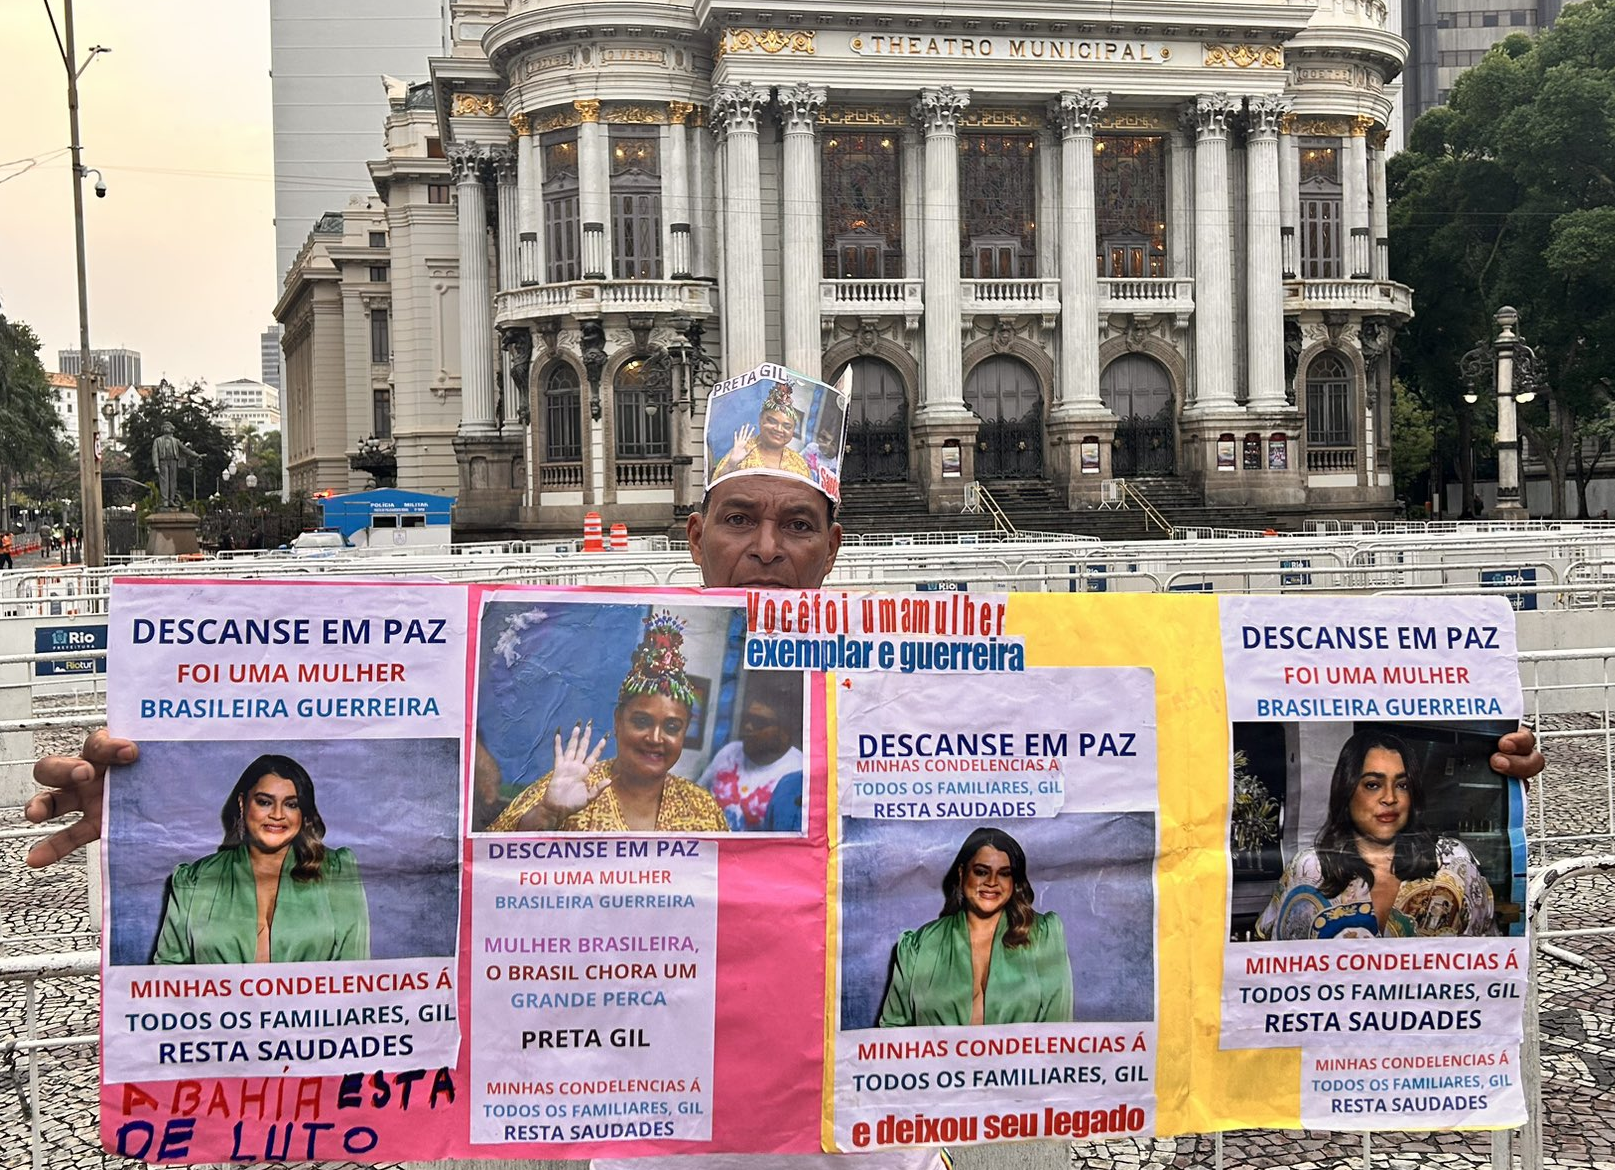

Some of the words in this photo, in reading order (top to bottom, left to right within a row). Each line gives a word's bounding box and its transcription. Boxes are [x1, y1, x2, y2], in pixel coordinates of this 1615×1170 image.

[872, 36, 992, 56] THEATRO
[1009, 40, 1153, 60] MUNICIPAL
[713, 371, 756, 396] PRETA
[760, 364, 787, 382] GIL
[69, 632, 94, 644] Rio
[133, 618, 309, 645] DESCANSE
[322, 619, 370, 645] EM
[383, 619, 447, 644] PAZ
[1242, 627, 1388, 649] DESCANSE
[1400, 627, 1436, 649] EM
[1450, 627, 1500, 649] PAZ
[747, 635, 873, 670] exemplar
[879, 641, 895, 669] e
[900, 636, 1024, 672] guerreira
[66, 661, 93, 670] Riotur
[177, 664, 219, 683] FOI
[229, 663, 289, 683] UMA
[298, 663, 406, 682] MULHER
[1284, 667, 1318, 684] FOI
[1327, 667, 1377, 684] UMA
[1383, 667, 1470, 684] MULHER
[140, 698, 289, 718] BRASILEIRA
[297, 697, 440, 717] GUERREIRA
[1257, 699, 1379, 717] BRASILEIRA
[1386, 698, 1502, 716] GUERREIRA
[859, 733, 1014, 758] DESCANSE
[1025, 733, 1068, 757] EM
[1079, 733, 1137, 757] PAZ
[856, 759, 920, 773] MINHAS
[925, 758, 1042, 772] CONDELENCIAS
[854, 782, 908, 796] TODOS
[913, 781, 933, 795] OS
[938, 781, 1033, 796] FAMILIARES,
[1038, 781, 1063, 794] GIL
[874, 802, 930, 818] RESTA
[936, 802, 1036, 818] SAUDADES
[488, 841, 607, 859] DESCANSE
[615, 841, 648, 858] EM
[657, 841, 699, 857] PAZ
[519, 872, 548, 885] FOI
[553, 871, 594, 885] UMA
[600, 870, 672, 884] MULHER
[495, 896, 593, 910] BRASILEIRA
[599, 894, 695, 908] GUERREIRA
[485, 937, 571, 953] MULHER
[578, 936, 699, 954] BRASILEIRA,
[486, 966, 501, 981] O
[508, 964, 579, 981] BRASIL
[585, 963, 657, 980] CHORA
[664, 963, 697, 978] UM
[1246, 956, 1329, 975] MINHAS
[1336, 953, 1499, 972] CONDELENCIAS
[1505, 949, 1519, 969] Á
[130, 978, 232, 998] MINHAS
[240, 972, 429, 996] CONDELENCIAS
[435, 967, 452, 989] Á
[1239, 986, 1311, 1004] TODOS
[1318, 984, 1345, 1001] OS
[1352, 983, 1481, 1002] FAMILIARES,
[1487, 982, 1520, 998] GIL
[511, 993, 596, 1008] GRANDE
[603, 991, 667, 1007] PERCA
[125, 1012, 212, 1032] TODOS
[220, 1011, 251, 1030] OS
[260, 1005, 410, 1028] FAMILIARES,
[418, 1004, 456, 1023] GIL
[1265, 1012, 1341, 1033] RESTA
[1348, 1009, 1482, 1031] SAUDADES
[159, 1041, 249, 1064] RESTA
[258, 1034, 414, 1061] SAUDADES
[522, 1029, 602, 1049] PRETA
[609, 1028, 650, 1047] GIL
[858, 1040, 948, 1060] MINHAS
[955, 1036, 1125, 1057] CONDELENCIAS
[1131, 1032, 1147, 1052] Á
[1315, 1058, 1377, 1071] MINHAS
[1381, 1054, 1494, 1069] CONDELENCIAS
[1498, 1050, 1509, 1065] Á
[487, 1081, 554, 1095] MINHAS
[559, 1080, 685, 1095] CONDELENCIAS
[690, 1077, 701, 1093] Á
[852, 1073, 929, 1092] TODOS
[936, 1071, 965, 1088] OS
[973, 1067, 1107, 1087] FAMILIARES,
[1114, 1066, 1149, 1083] GIL
[1312, 1079, 1364, 1092] TODOS
[1369, 1079, 1388, 1091] OS
[1393, 1076, 1484, 1090] FAMILIARES,
[1489, 1074, 1512, 1086] GIL
[122, 1082, 159, 1116] A
[337, 1067, 456, 1110] ESTA
[483, 1104, 540, 1118] TODOS
[546, 1104, 567, 1117] OS
[572, 1102, 672, 1119] FAMILIARES,
[678, 1101, 703, 1115] GIL
[1332, 1098, 1386, 1113] RESTA
[1392, 1095, 1487, 1112] SAUDADES
[504, 1125, 564, 1141] RESTA
[570, 1122, 675, 1139] SAUDADES
[852, 1121, 870, 1147] e
[876, 1114, 978, 1145] deixou
[984, 1111, 1038, 1138] seu
[1044, 1104, 1145, 1138] legado
[116, 1118, 197, 1162] DE
[230, 1120, 378, 1162] LUTO
